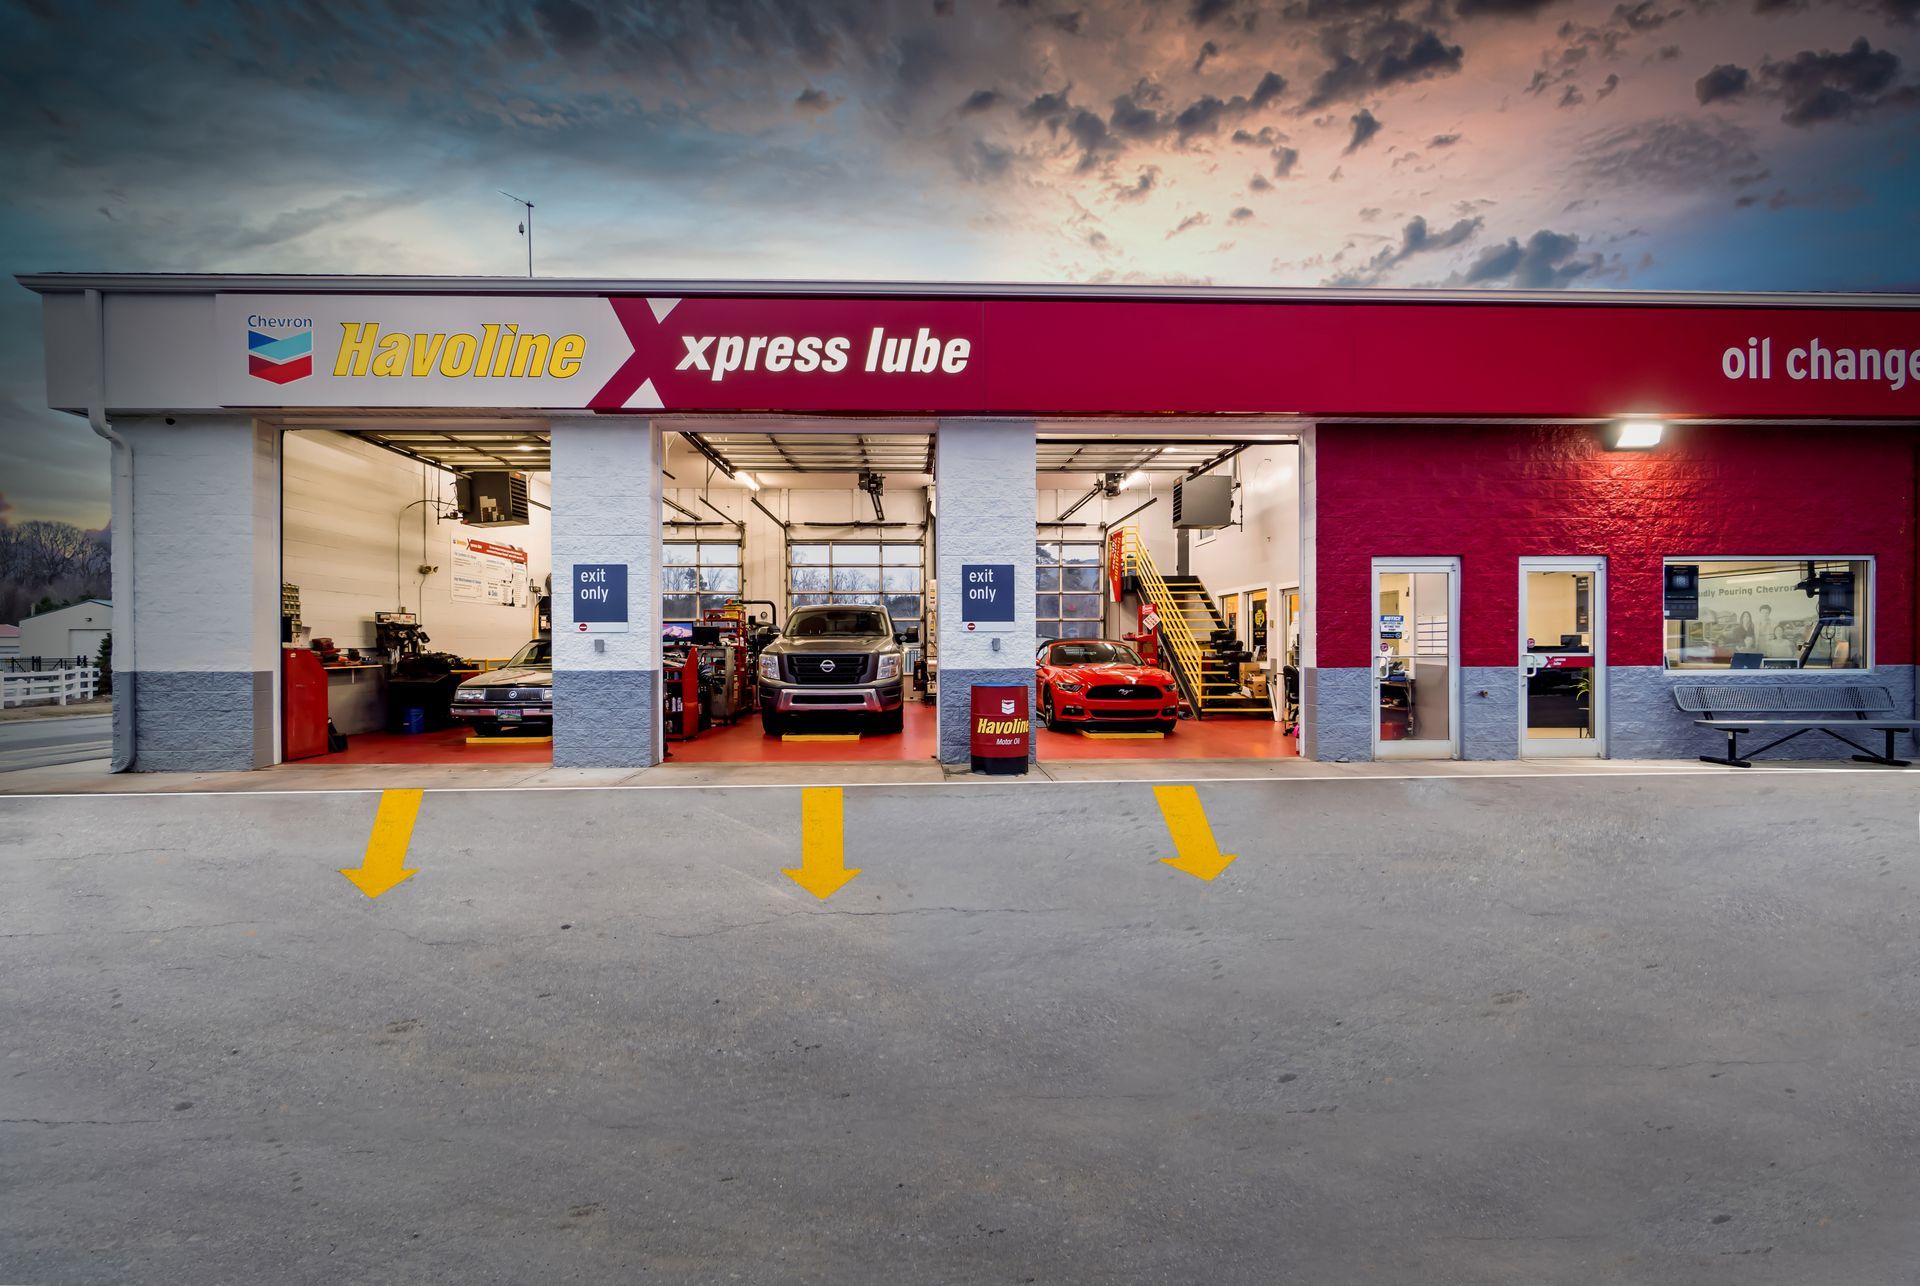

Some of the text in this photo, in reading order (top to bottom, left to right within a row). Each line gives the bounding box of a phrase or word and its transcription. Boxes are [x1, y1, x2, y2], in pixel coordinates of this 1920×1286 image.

[247, 314, 313, 329] Chevron
[332, 322, 587, 379] Havoline
[675, 335, 851, 382] xpress
[864, 327, 971, 374] lube
[1722, 336, 1771, 379] oil
[580, 568, 606, 583] exit
[969, 568, 994, 583] exit
[580, 585, 609, 603] only
[969, 585, 996, 603] only
[1718, 587, 1753, 596] Pouring
[995, 737, 1021, 746] Motor Oil
